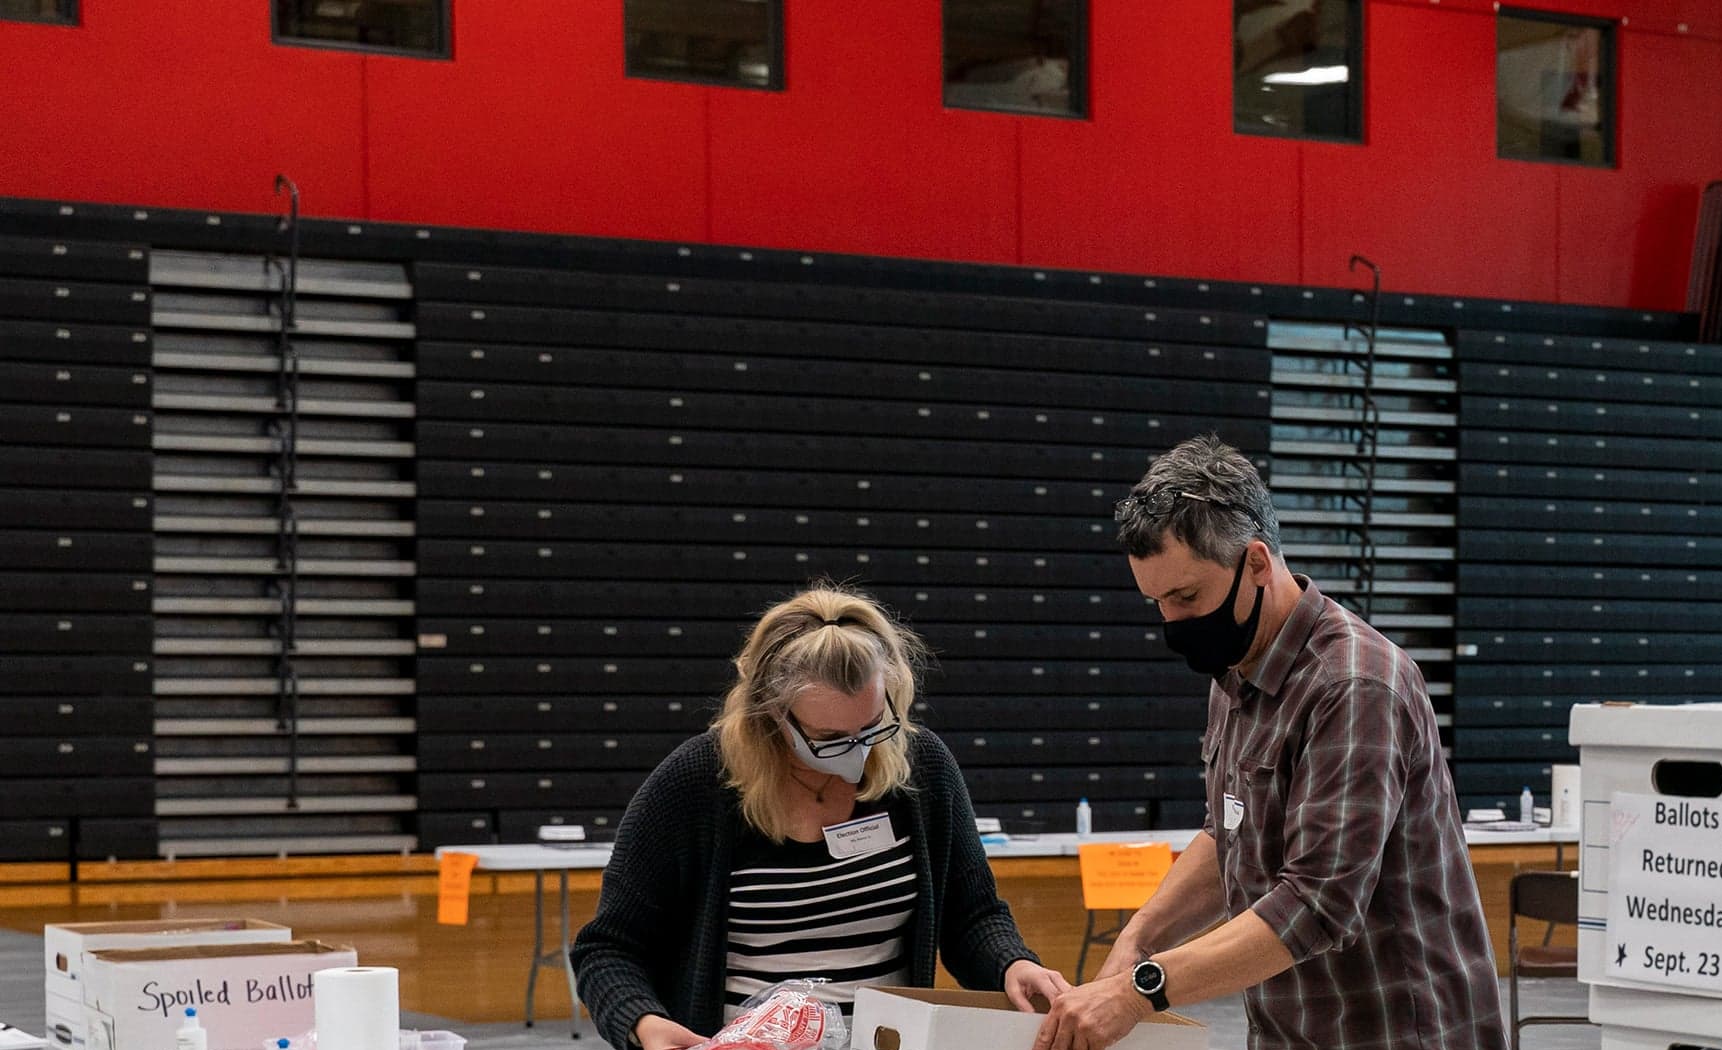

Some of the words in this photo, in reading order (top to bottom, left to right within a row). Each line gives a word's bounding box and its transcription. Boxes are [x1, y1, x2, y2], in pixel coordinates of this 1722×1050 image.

[859, 824, 879, 832] Official
[1656, 802, 1718, 829] Ballots
[1644, 946, 1690, 976] Sept.
[1698, 953, 1720, 976] 23
[138, 979, 230, 1017] Spoiled
[247, 974, 313, 1002] Ballot
